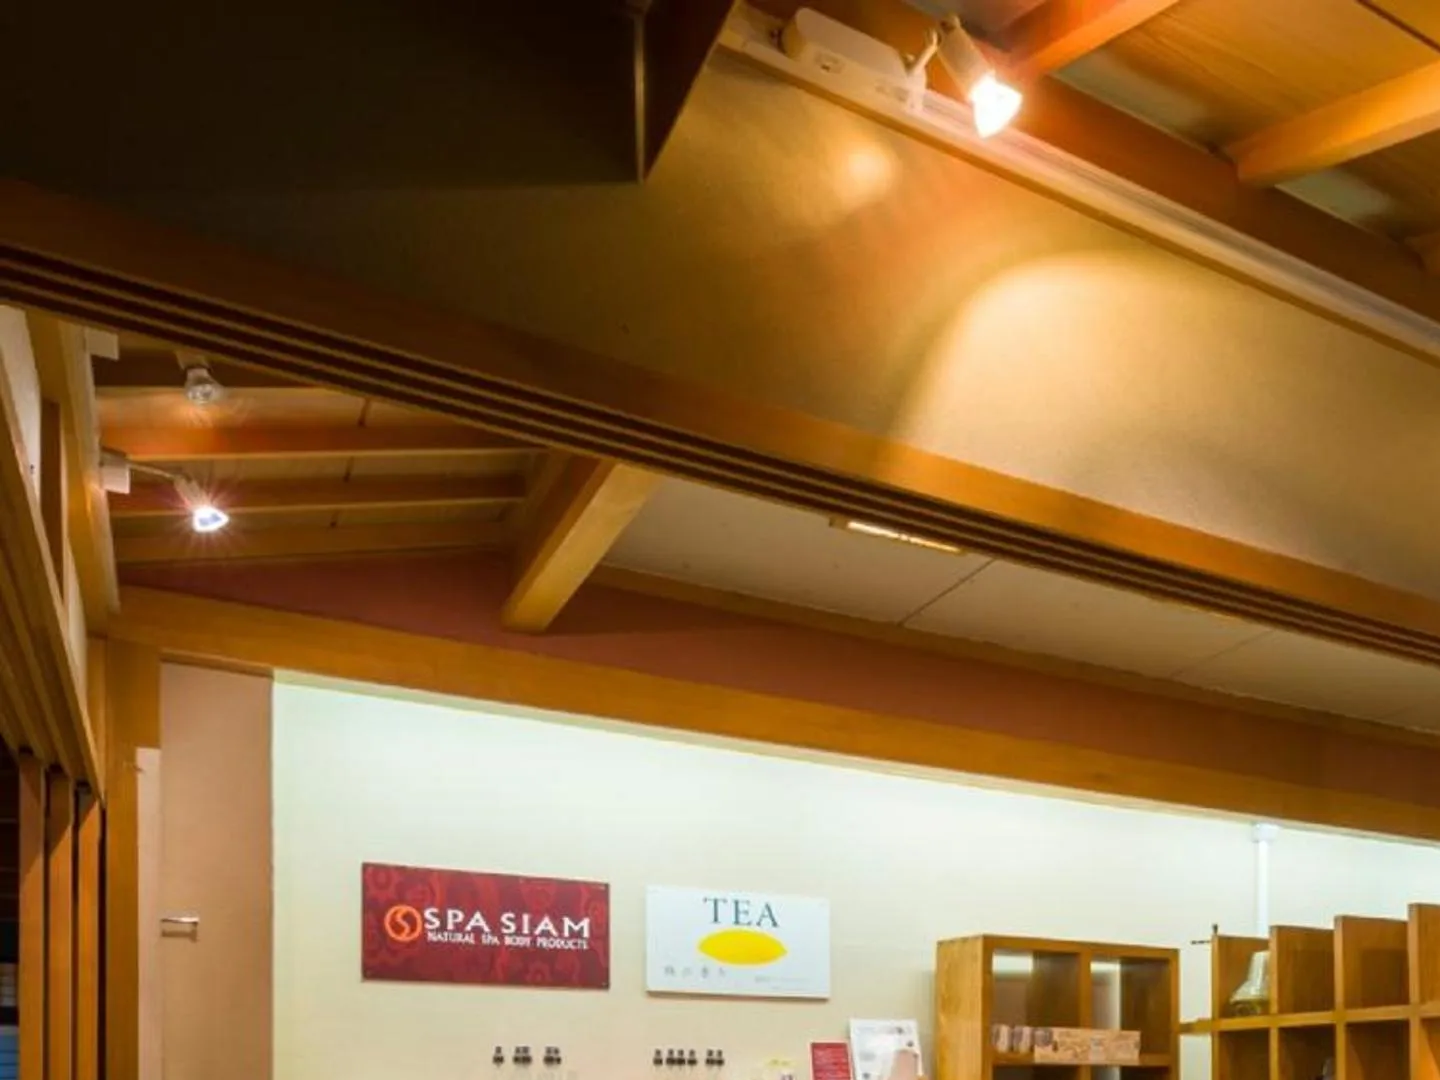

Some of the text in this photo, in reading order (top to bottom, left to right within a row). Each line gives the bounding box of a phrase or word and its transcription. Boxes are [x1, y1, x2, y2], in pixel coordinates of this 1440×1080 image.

[424, 907, 590, 939] SPA SIAM
[703, 897, 779, 928] TEA
[427, 931, 476, 945] NATURAL
